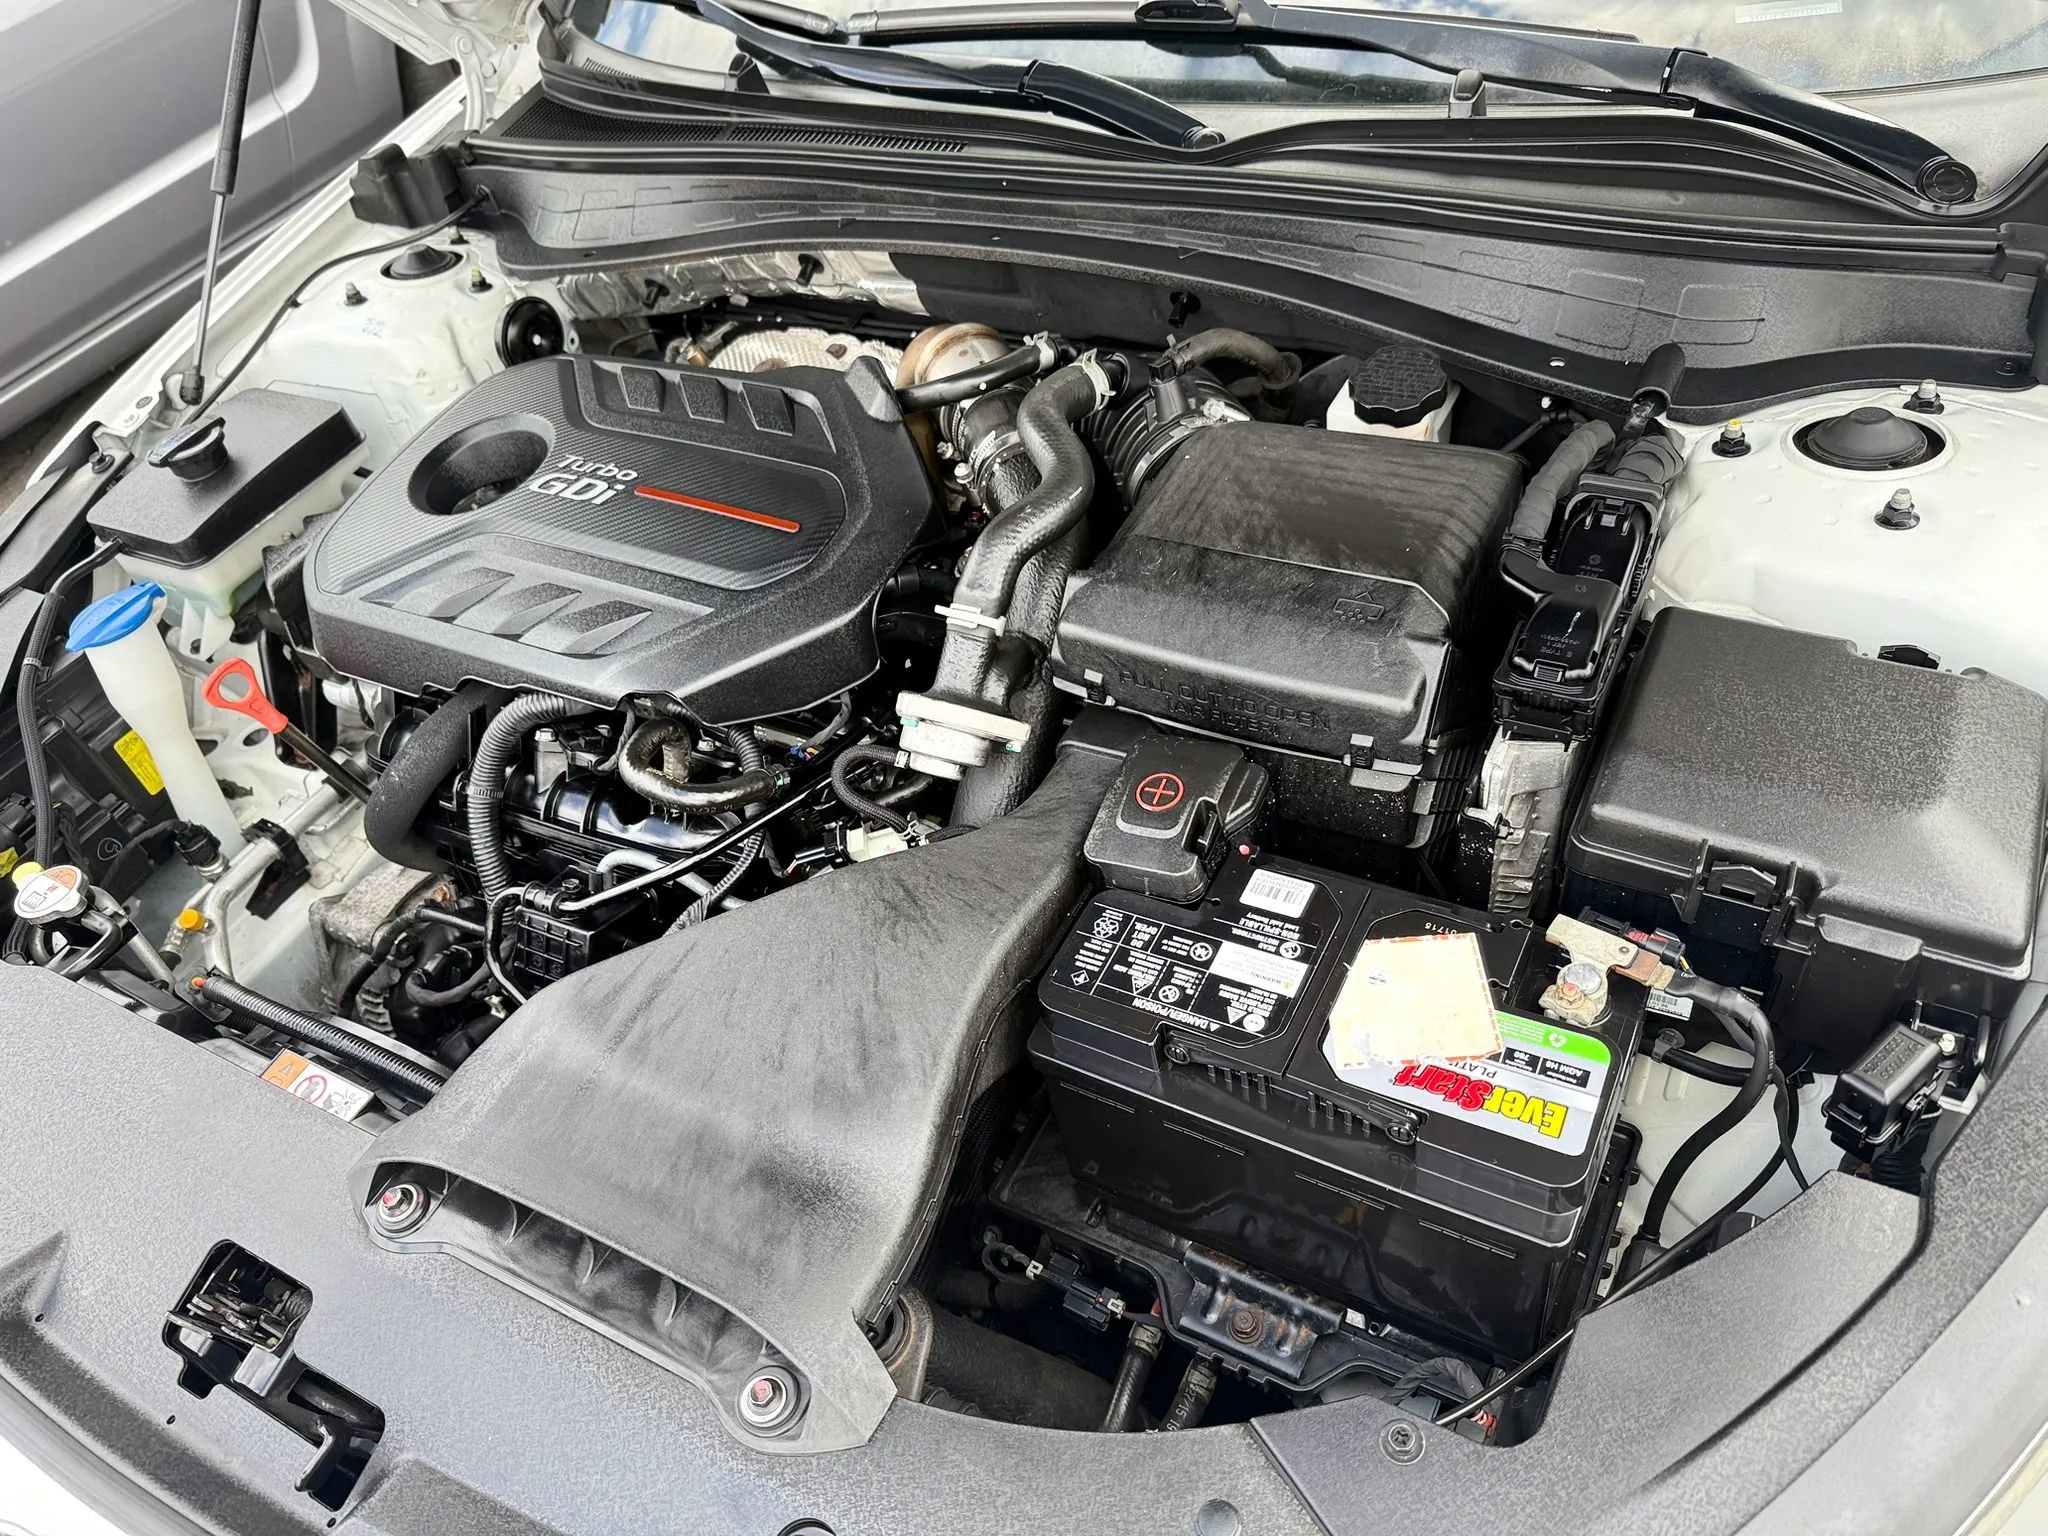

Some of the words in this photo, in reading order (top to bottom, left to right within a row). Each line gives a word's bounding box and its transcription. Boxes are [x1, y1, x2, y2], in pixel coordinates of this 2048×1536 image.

[556, 454, 638, 482] Turbo
[528, 473, 625, 504] GDi
[1120, 671, 1173, 696] PULL
[1177, 683, 1223, 706] OUT
[1228, 696, 1257, 715] TO
[1264, 705, 1332, 731] OPEN
[1135, 922, 1159, 935] OPEN.
[1239, 918, 1301, 942] NON-SPILLABLE
[1269, 919, 1285, 928] Acid
[1284, 923, 1300, 933] Lead
[1130, 939, 1145, 949] DO
[1132, 931, 1151, 942] NOT
[1258, 943, 1277, 953] READ
[1132, 998, 1210, 1030] DANGER/POISON
[1393, 1064, 1569, 1139] EverStart
